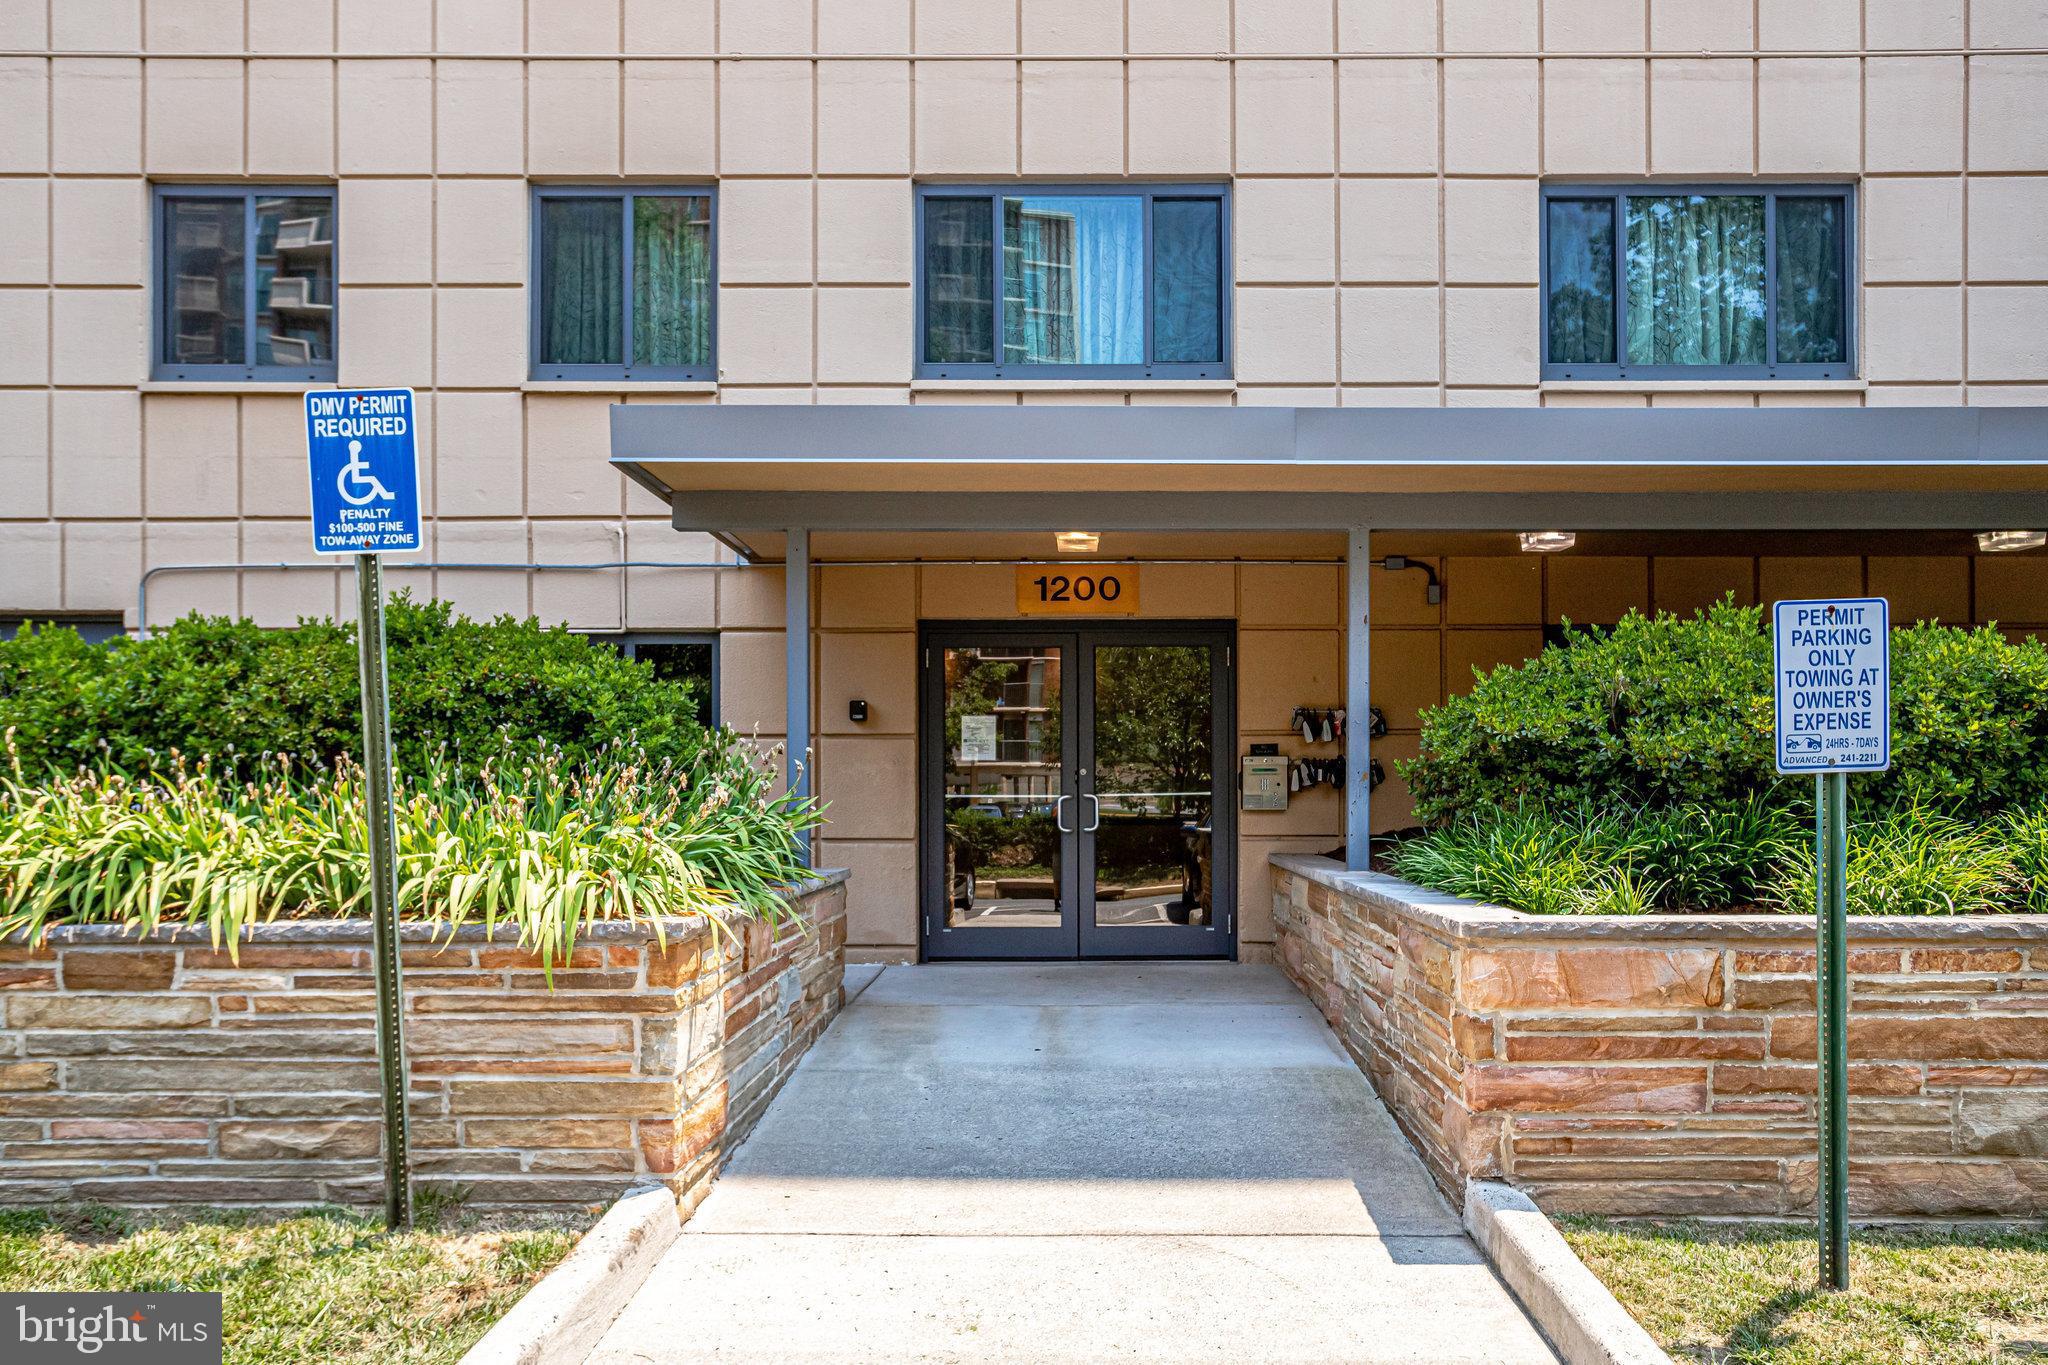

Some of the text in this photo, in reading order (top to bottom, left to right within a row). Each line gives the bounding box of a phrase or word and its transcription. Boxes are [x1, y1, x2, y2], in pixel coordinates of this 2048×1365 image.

[310, 395, 408, 416] DMV PERMIT
[314, 417, 407, 437] REQUIRED
[339, 508, 391, 519] PENALTY
[328, 521, 404, 533] $100-500 FINE
[320, 533, 414, 546] TOW-AWAY ZONE
[1033, 576, 1121, 601] 1200
[1798, 607, 1865, 626] PERMIT
[1791, 628, 1872, 647] PARKING
[1808, 649, 1856, 667] ONLY
[1785, 668, 1880, 688] TOWING AT
[1793, 690, 1872, 709] OWNER'S
[1793, 711, 1872, 731] EXPENSE
[1825, 737, 1850, 749] 24HRS
[1856, 737, 1879, 748] 7DAYS
[1783, 753, 1877, 765] ADVANCED 241-2211
